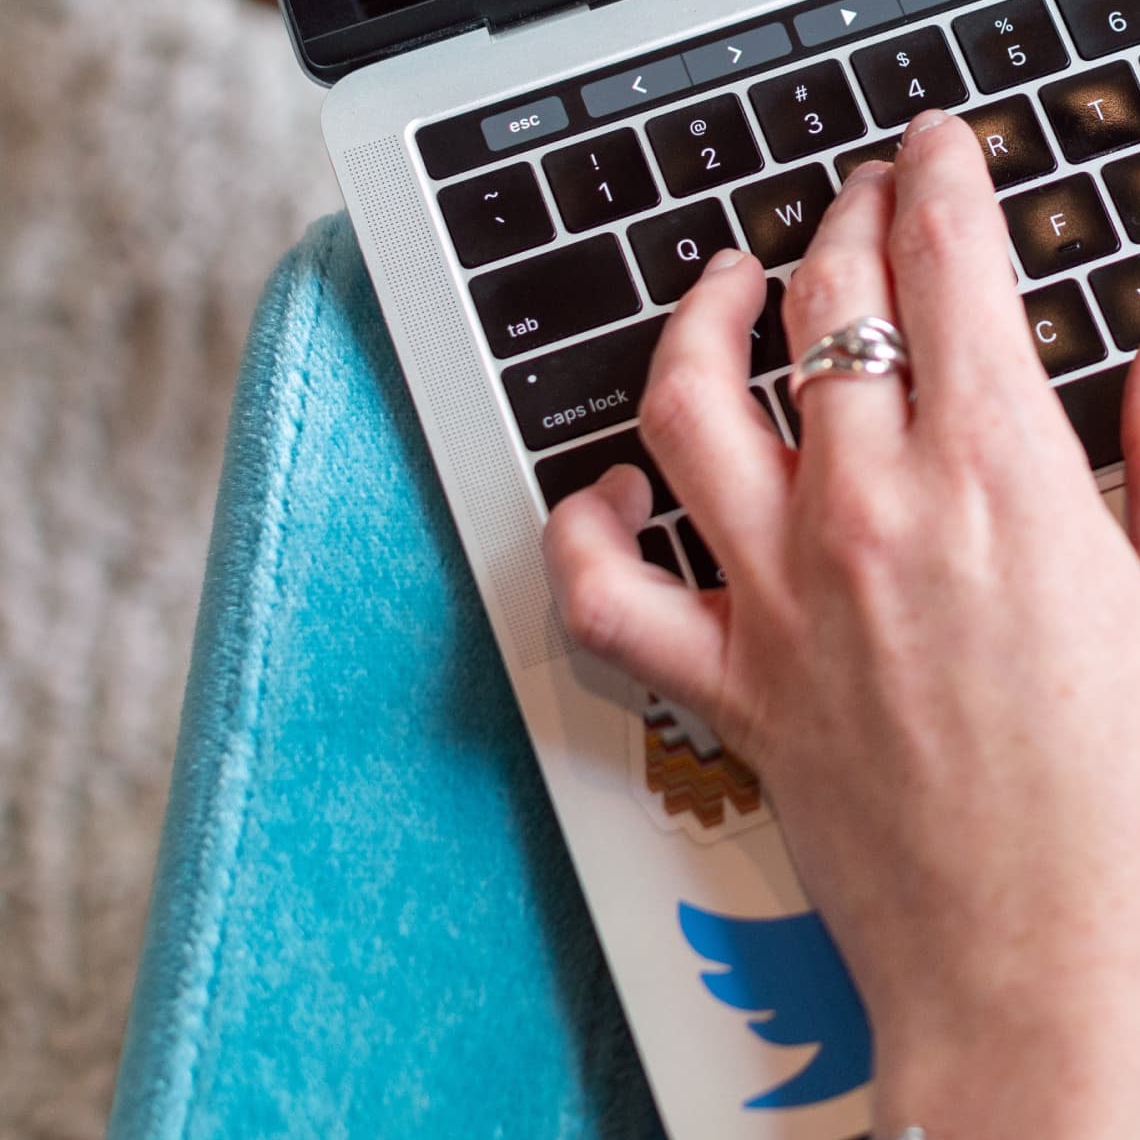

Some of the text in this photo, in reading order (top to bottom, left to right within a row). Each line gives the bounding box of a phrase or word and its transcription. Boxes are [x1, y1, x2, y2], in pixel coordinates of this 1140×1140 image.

[1109, 12, 1127, 32] 6
[1008, 45, 1026, 66] 5
[909, 79, 925, 97] 4
[1087, 99, 1104, 120] T
[510, 115, 540, 132] esc
[804, 113, 823, 134] 3
[986, 135, 1008, 157] R
[701, 148, 720, 169] 2
[599, 182, 612, 202] 1
[775, 202, 802, 227] W
[1050, 213, 1066, 236] F
[677, 239, 700, 261] Q
[507, 318, 538, 337] tab
[1035, 321, 1057, 343] C
[542, 389, 630, 430] caps lock
